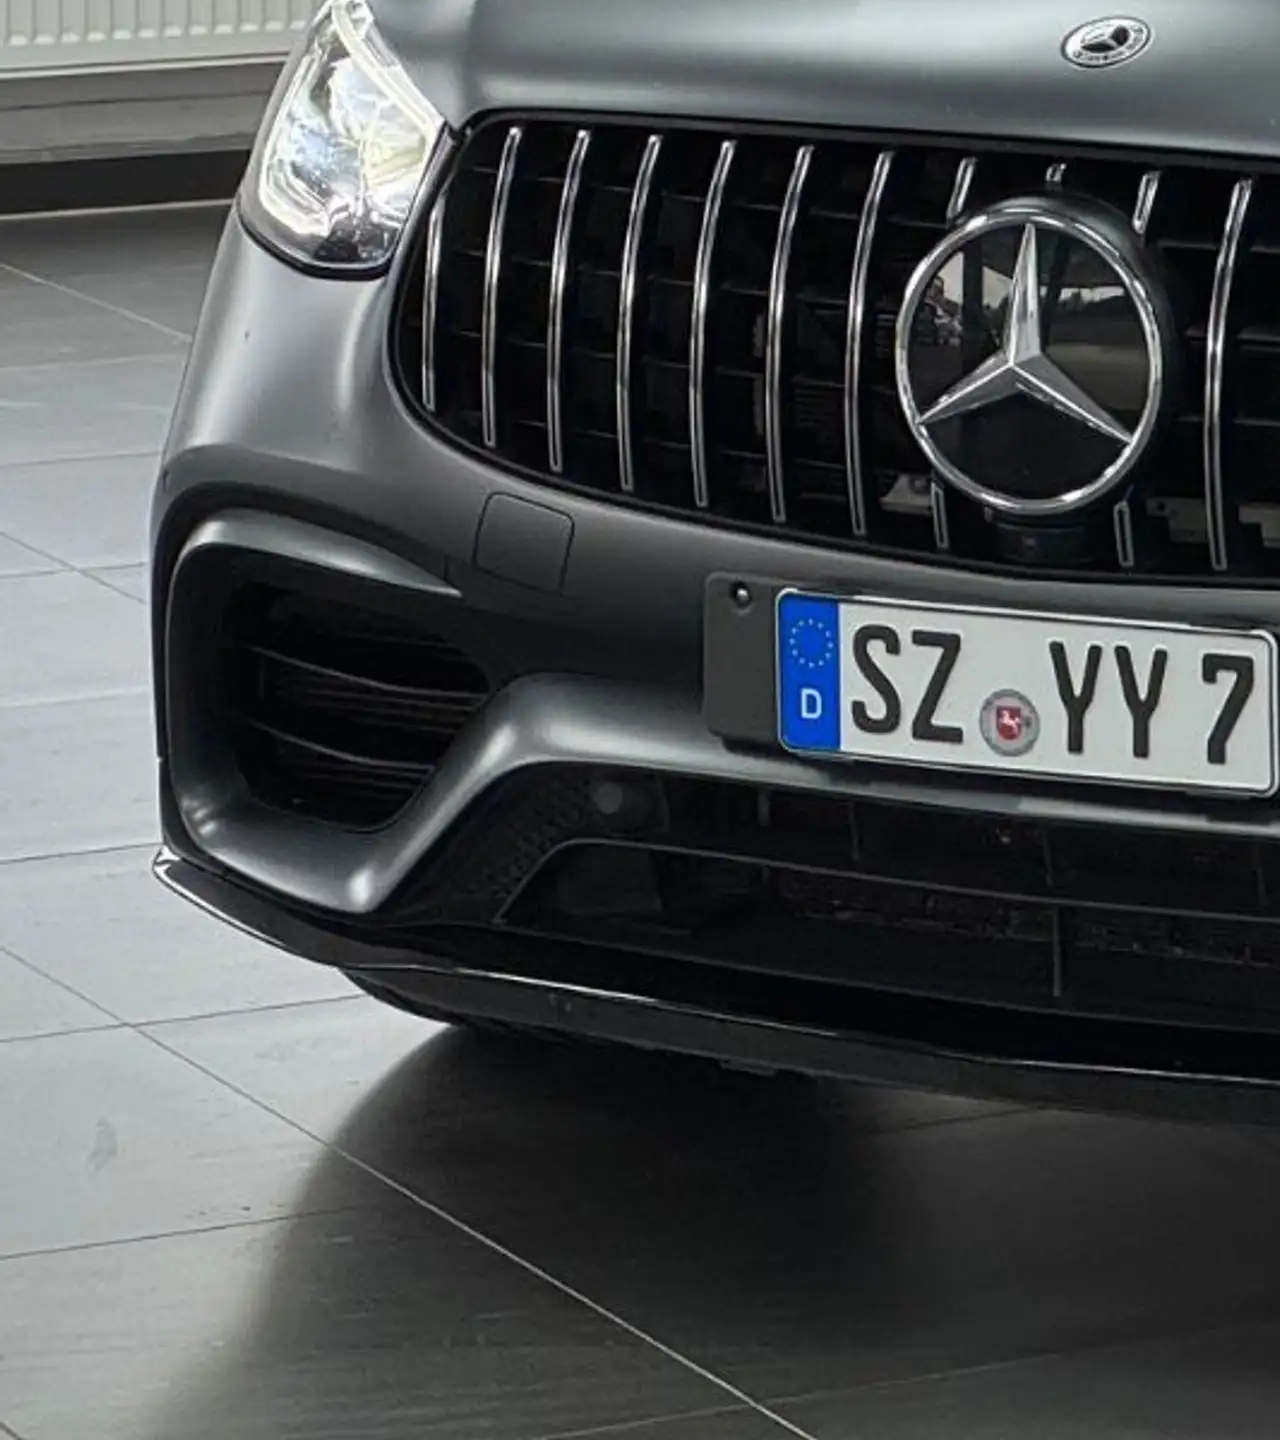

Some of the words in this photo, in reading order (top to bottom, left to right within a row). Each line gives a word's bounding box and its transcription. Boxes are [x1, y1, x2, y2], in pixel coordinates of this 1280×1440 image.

[801, 687, 822, 720] D
[850, 623, 964, 744] SZ
[1048, 640, 1169, 759] YY
[1200, 653, 1256, 765] 7
